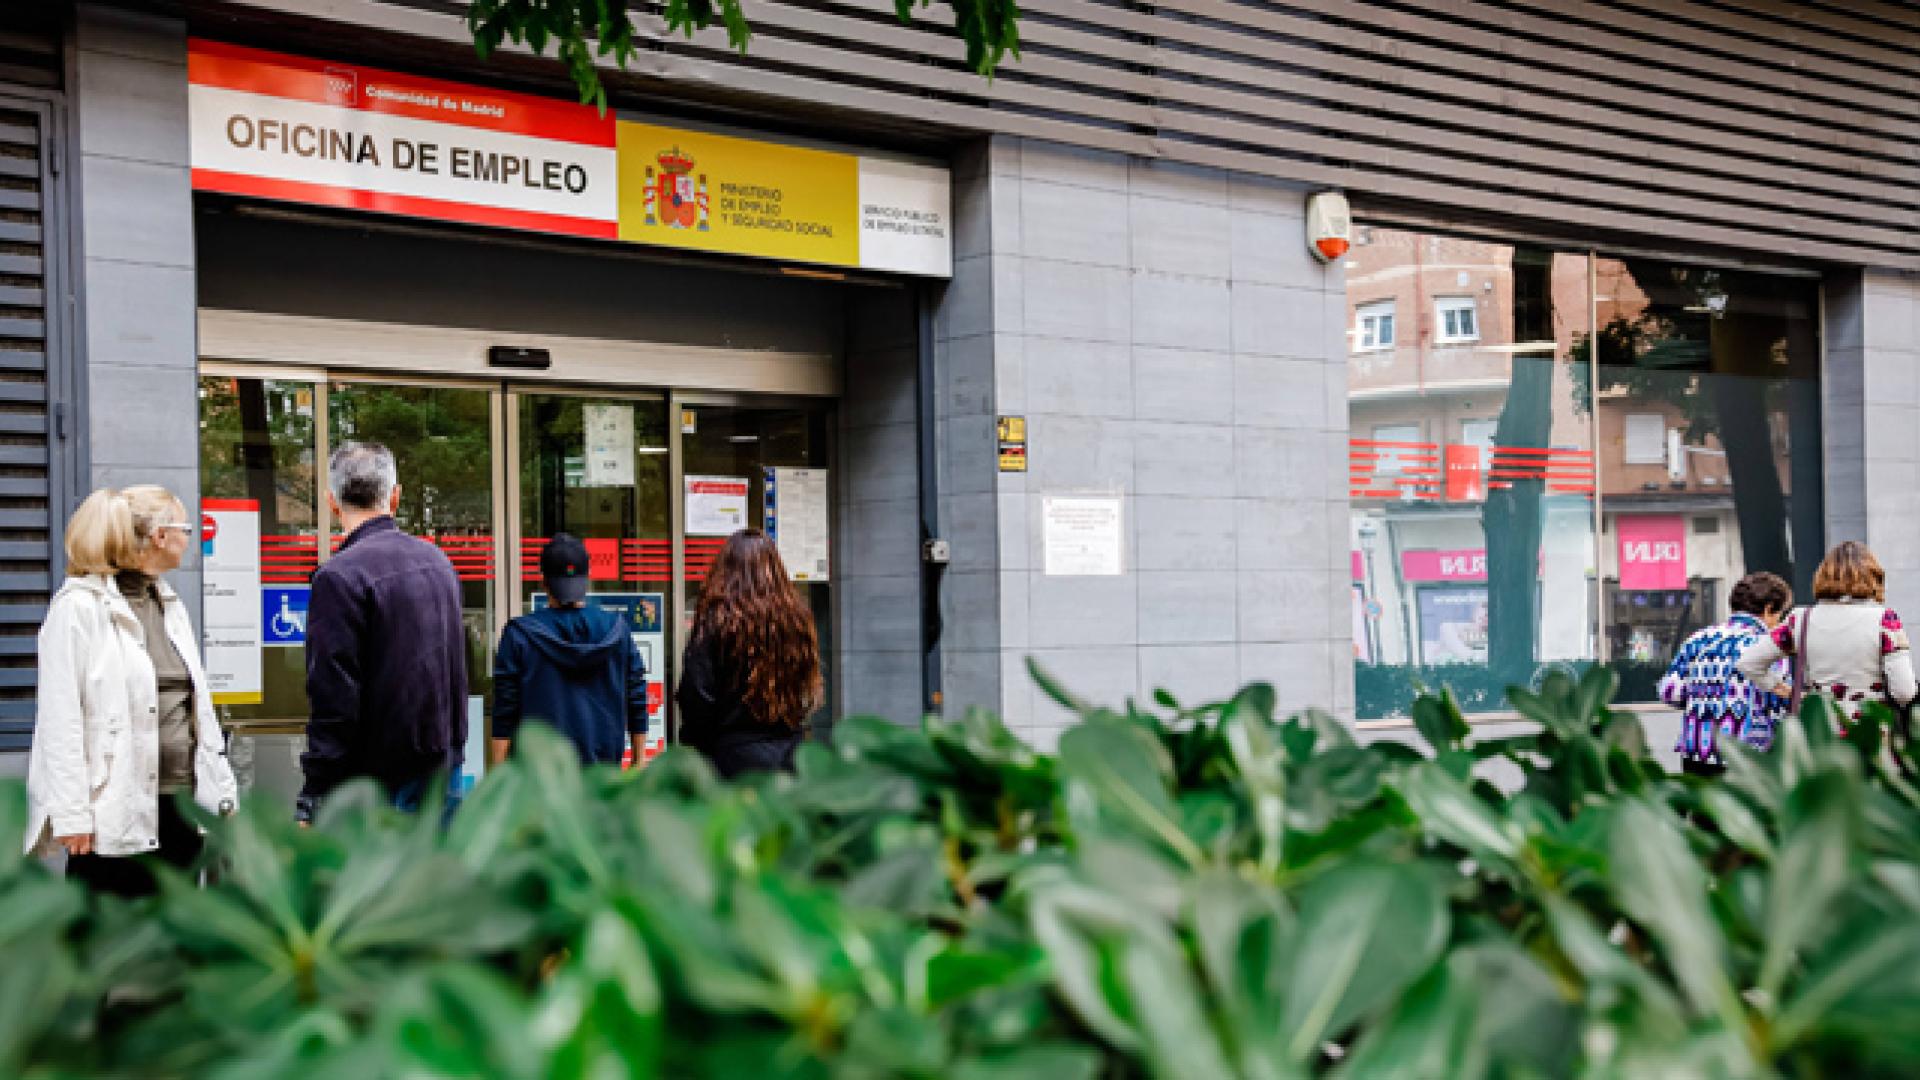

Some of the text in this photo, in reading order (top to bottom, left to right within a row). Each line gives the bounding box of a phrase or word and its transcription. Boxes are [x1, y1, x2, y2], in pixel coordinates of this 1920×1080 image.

[366, 84, 505, 118] Comunidad de Madrid
[227, 114, 588, 194] OFICINA DE EMPLEO
[720, 182, 782, 202] MINISTERIO
[720, 197, 782, 216] DE EMPLEO
[720, 212, 833, 238] Y SEGURIDAD SOCIAL
